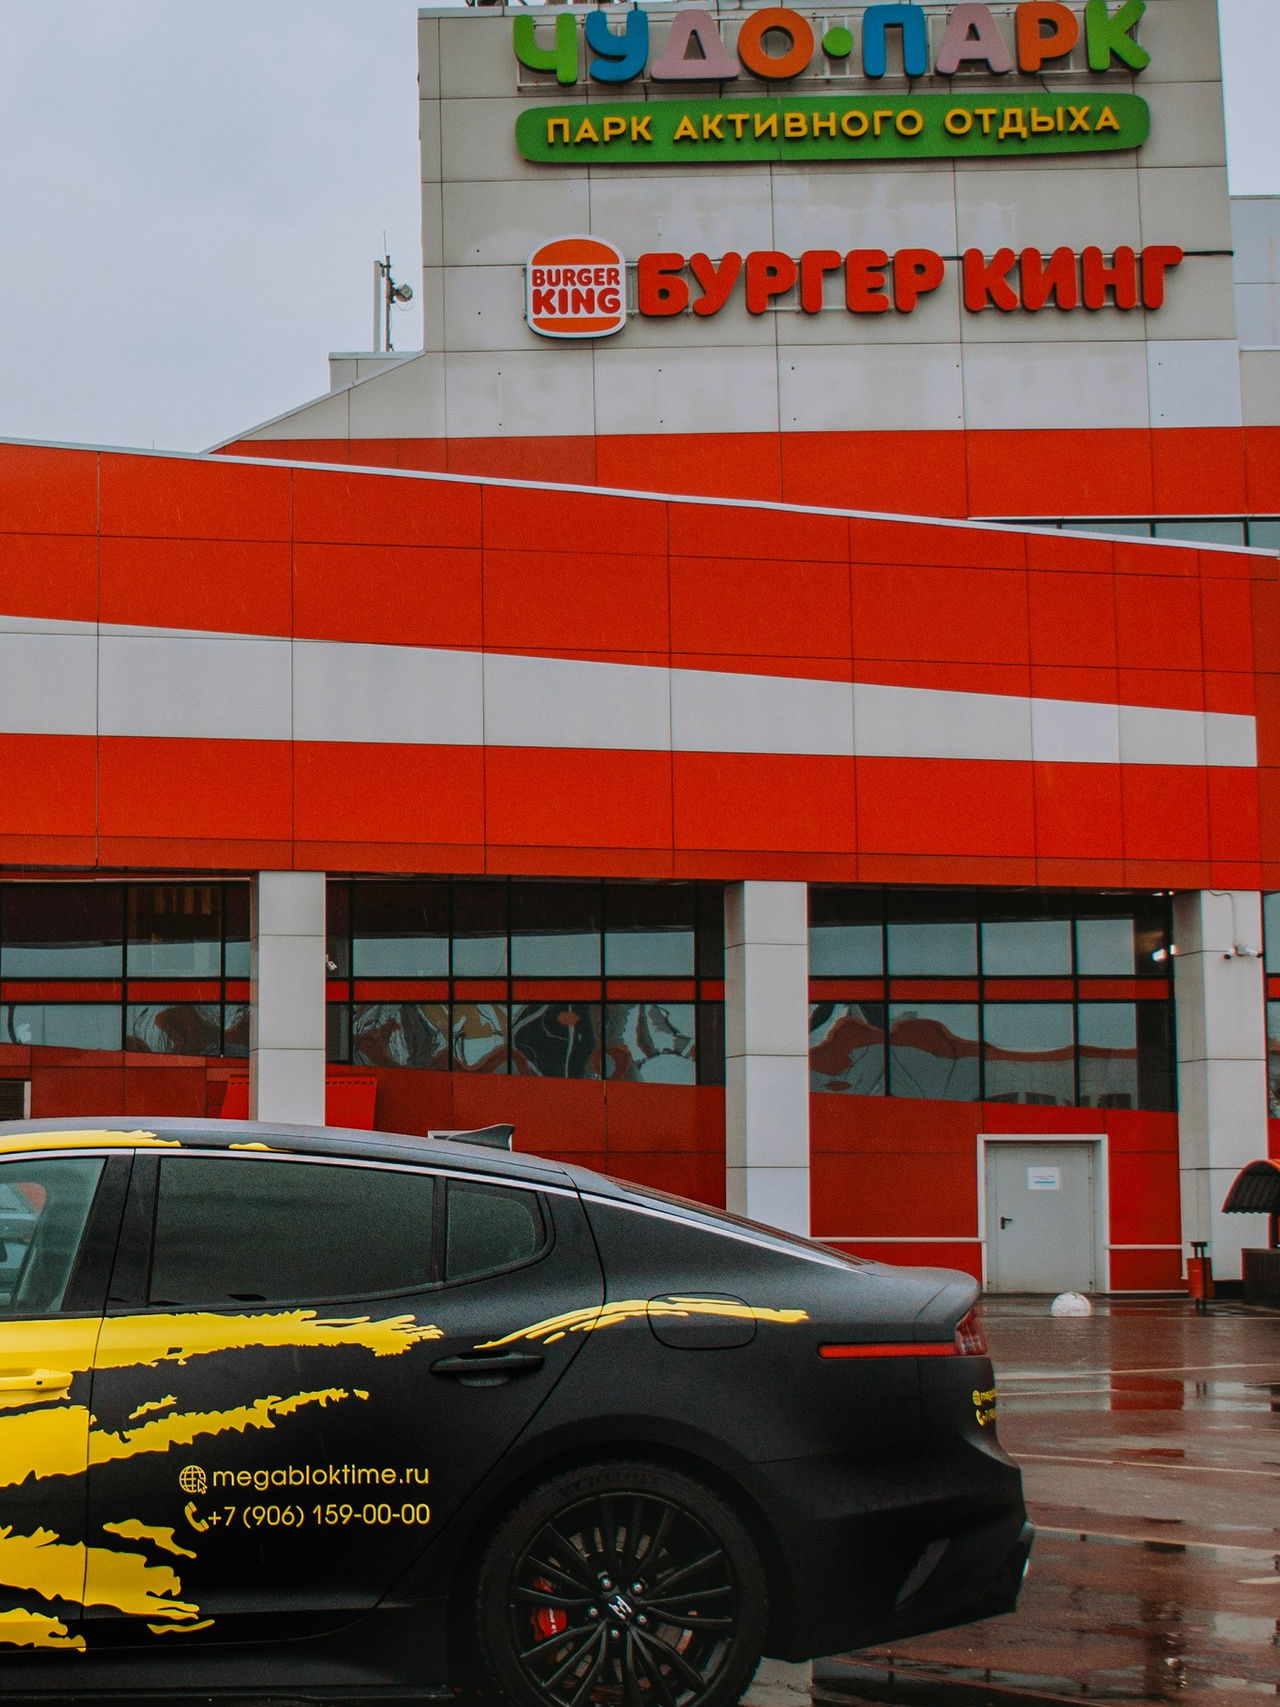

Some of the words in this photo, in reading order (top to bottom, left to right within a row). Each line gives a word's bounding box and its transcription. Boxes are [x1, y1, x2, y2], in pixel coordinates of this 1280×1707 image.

[547, 115, 653, 143] ПАРК
[673, 109, 923, 140] АКТИВНОГО
[944, 106, 1121, 140] ОТДЫХА
[531, 268, 621, 287] BURGER
[637, 248, 945, 317] БУРГЕР
[963, 245, 1184, 312] КИНГ
[532, 287, 621, 315] KING
[213, 1464, 430, 1491] megabloktime.ru
[208, 1506, 236, 1526] +7
[243, 1505, 304, 1529] (906)
[313, 1503, 431, 1526] 159-00-00
